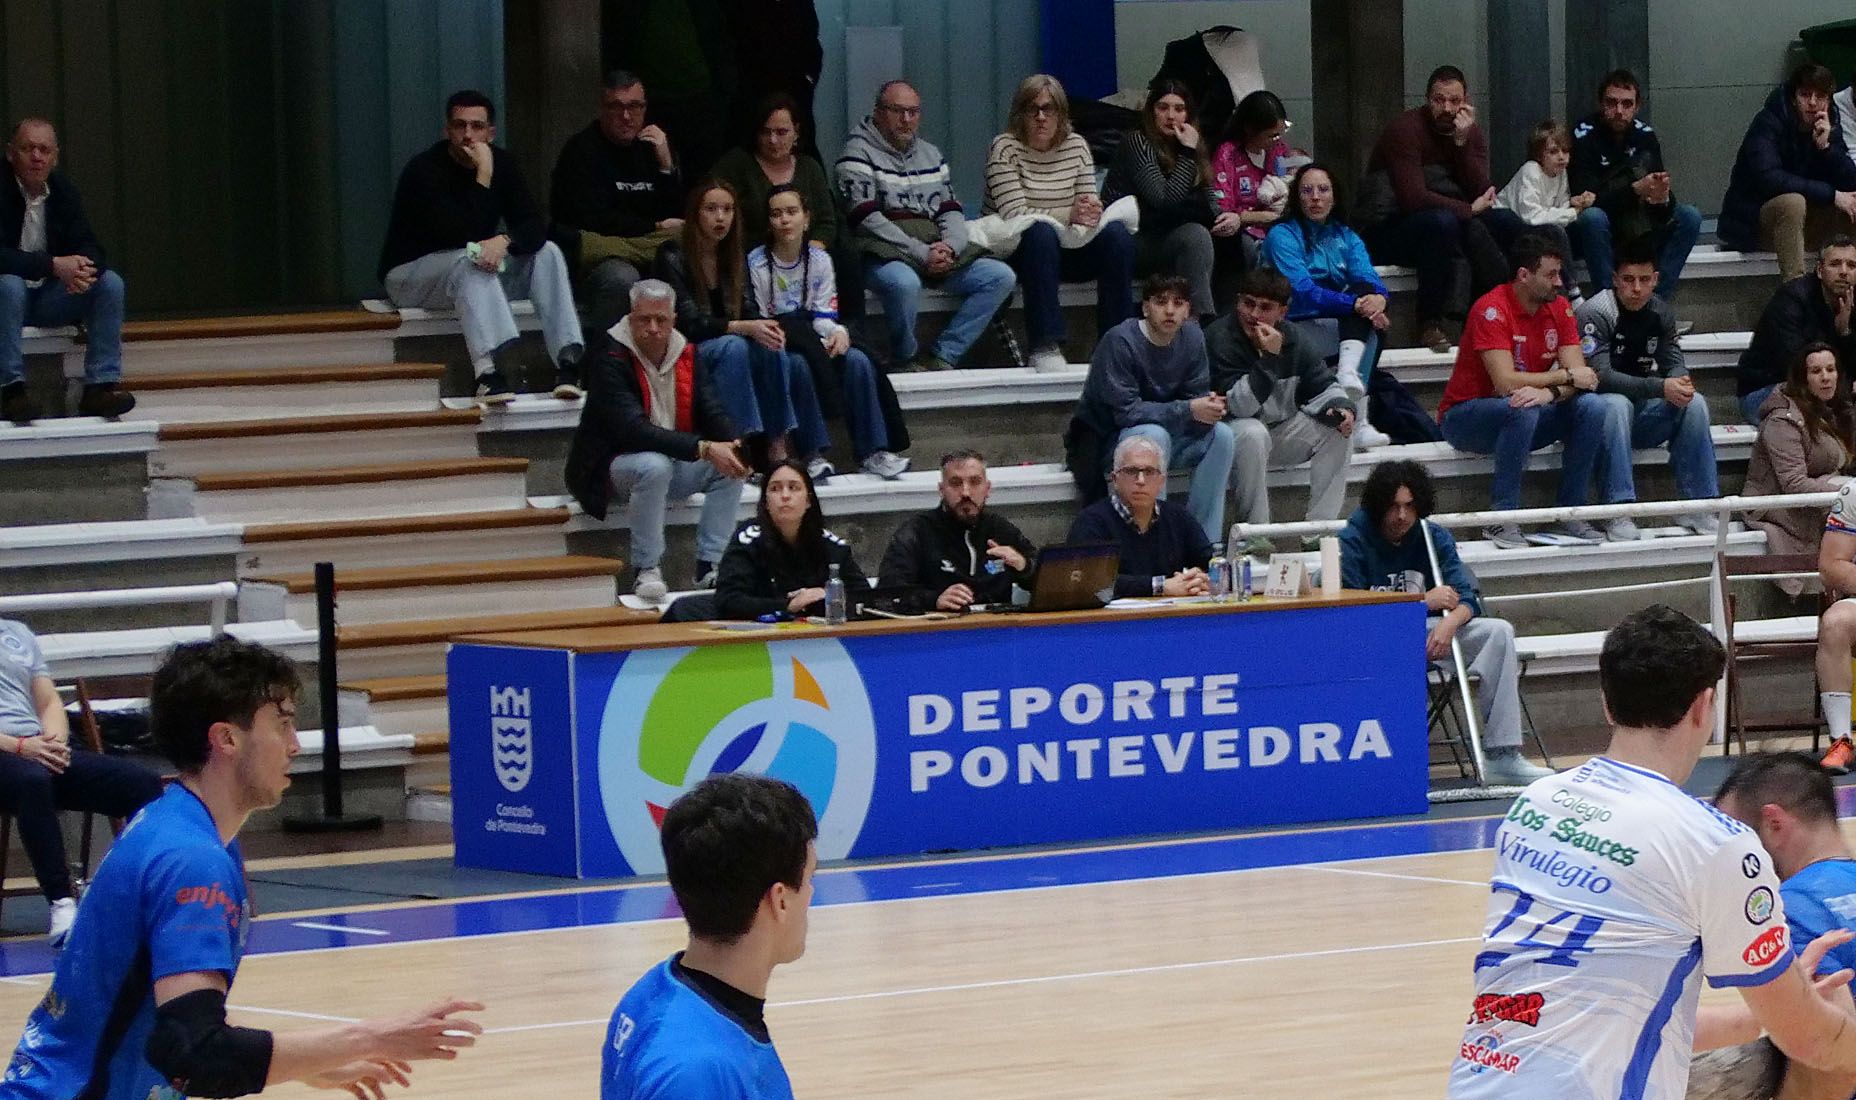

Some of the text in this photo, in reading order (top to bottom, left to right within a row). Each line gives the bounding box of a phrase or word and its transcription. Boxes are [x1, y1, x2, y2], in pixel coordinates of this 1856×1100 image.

[908, 672, 1240, 736] DEPORTE
[909, 719, 1394, 793] PONTEVEDRA
[1506, 797, 1640, 867] Los Sauces
[1551, 788, 1612, 822] Colegio
[1500, 831, 1612, 894] Virulegio
[1473, 880, 1604, 974] 24
